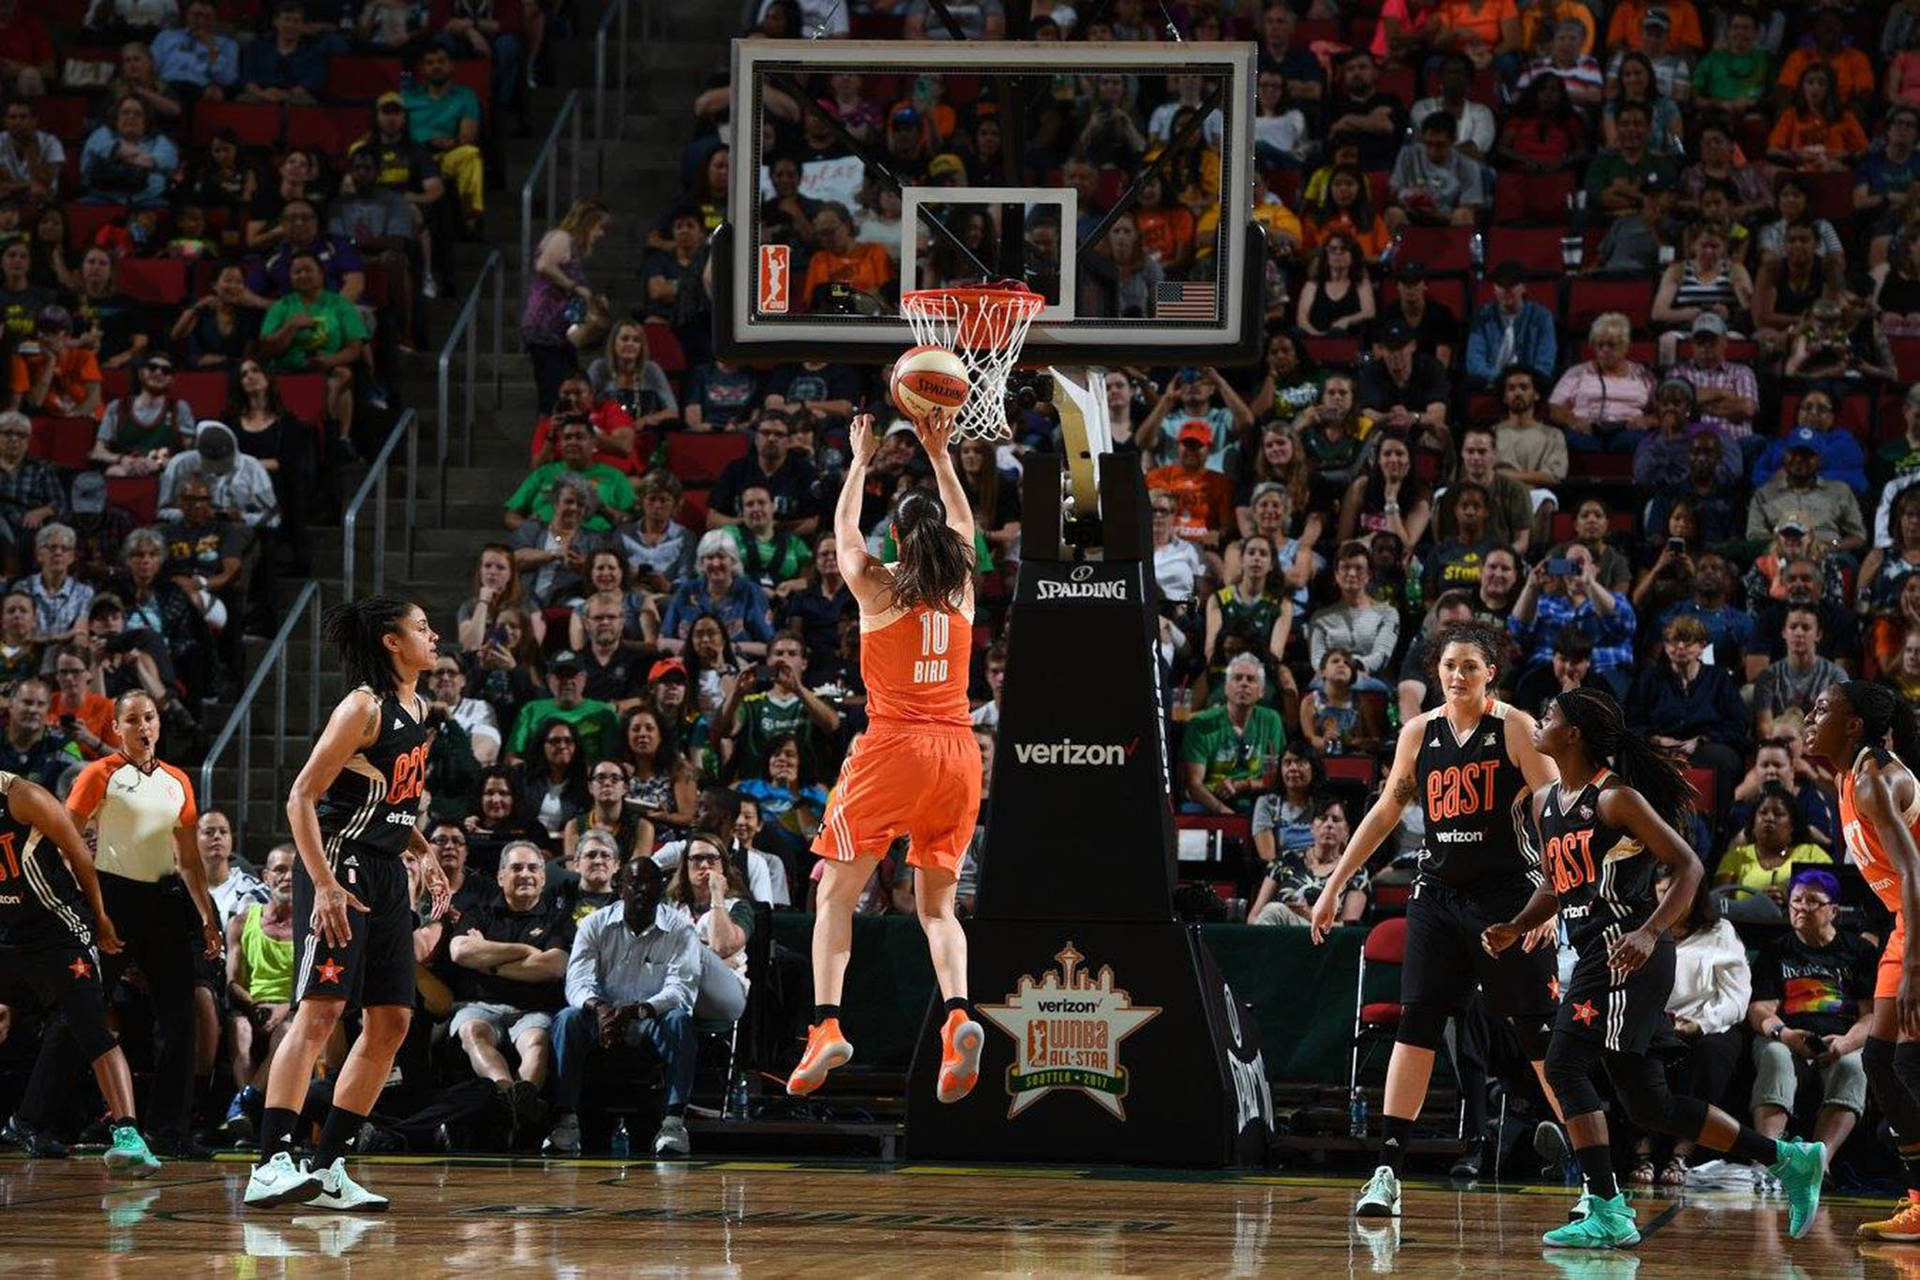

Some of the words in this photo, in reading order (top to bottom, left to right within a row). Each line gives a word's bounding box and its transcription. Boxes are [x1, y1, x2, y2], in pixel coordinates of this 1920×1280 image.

[1037, 579, 1127, 600] SPALDING
[919, 611, 949, 656] 10
[913, 659, 948, 683] BIRD
[1014, 738, 1125, 765] verizon
[1436, 829, 1483, 843] verizon
[1038, 999, 1096, 1013] verizon
